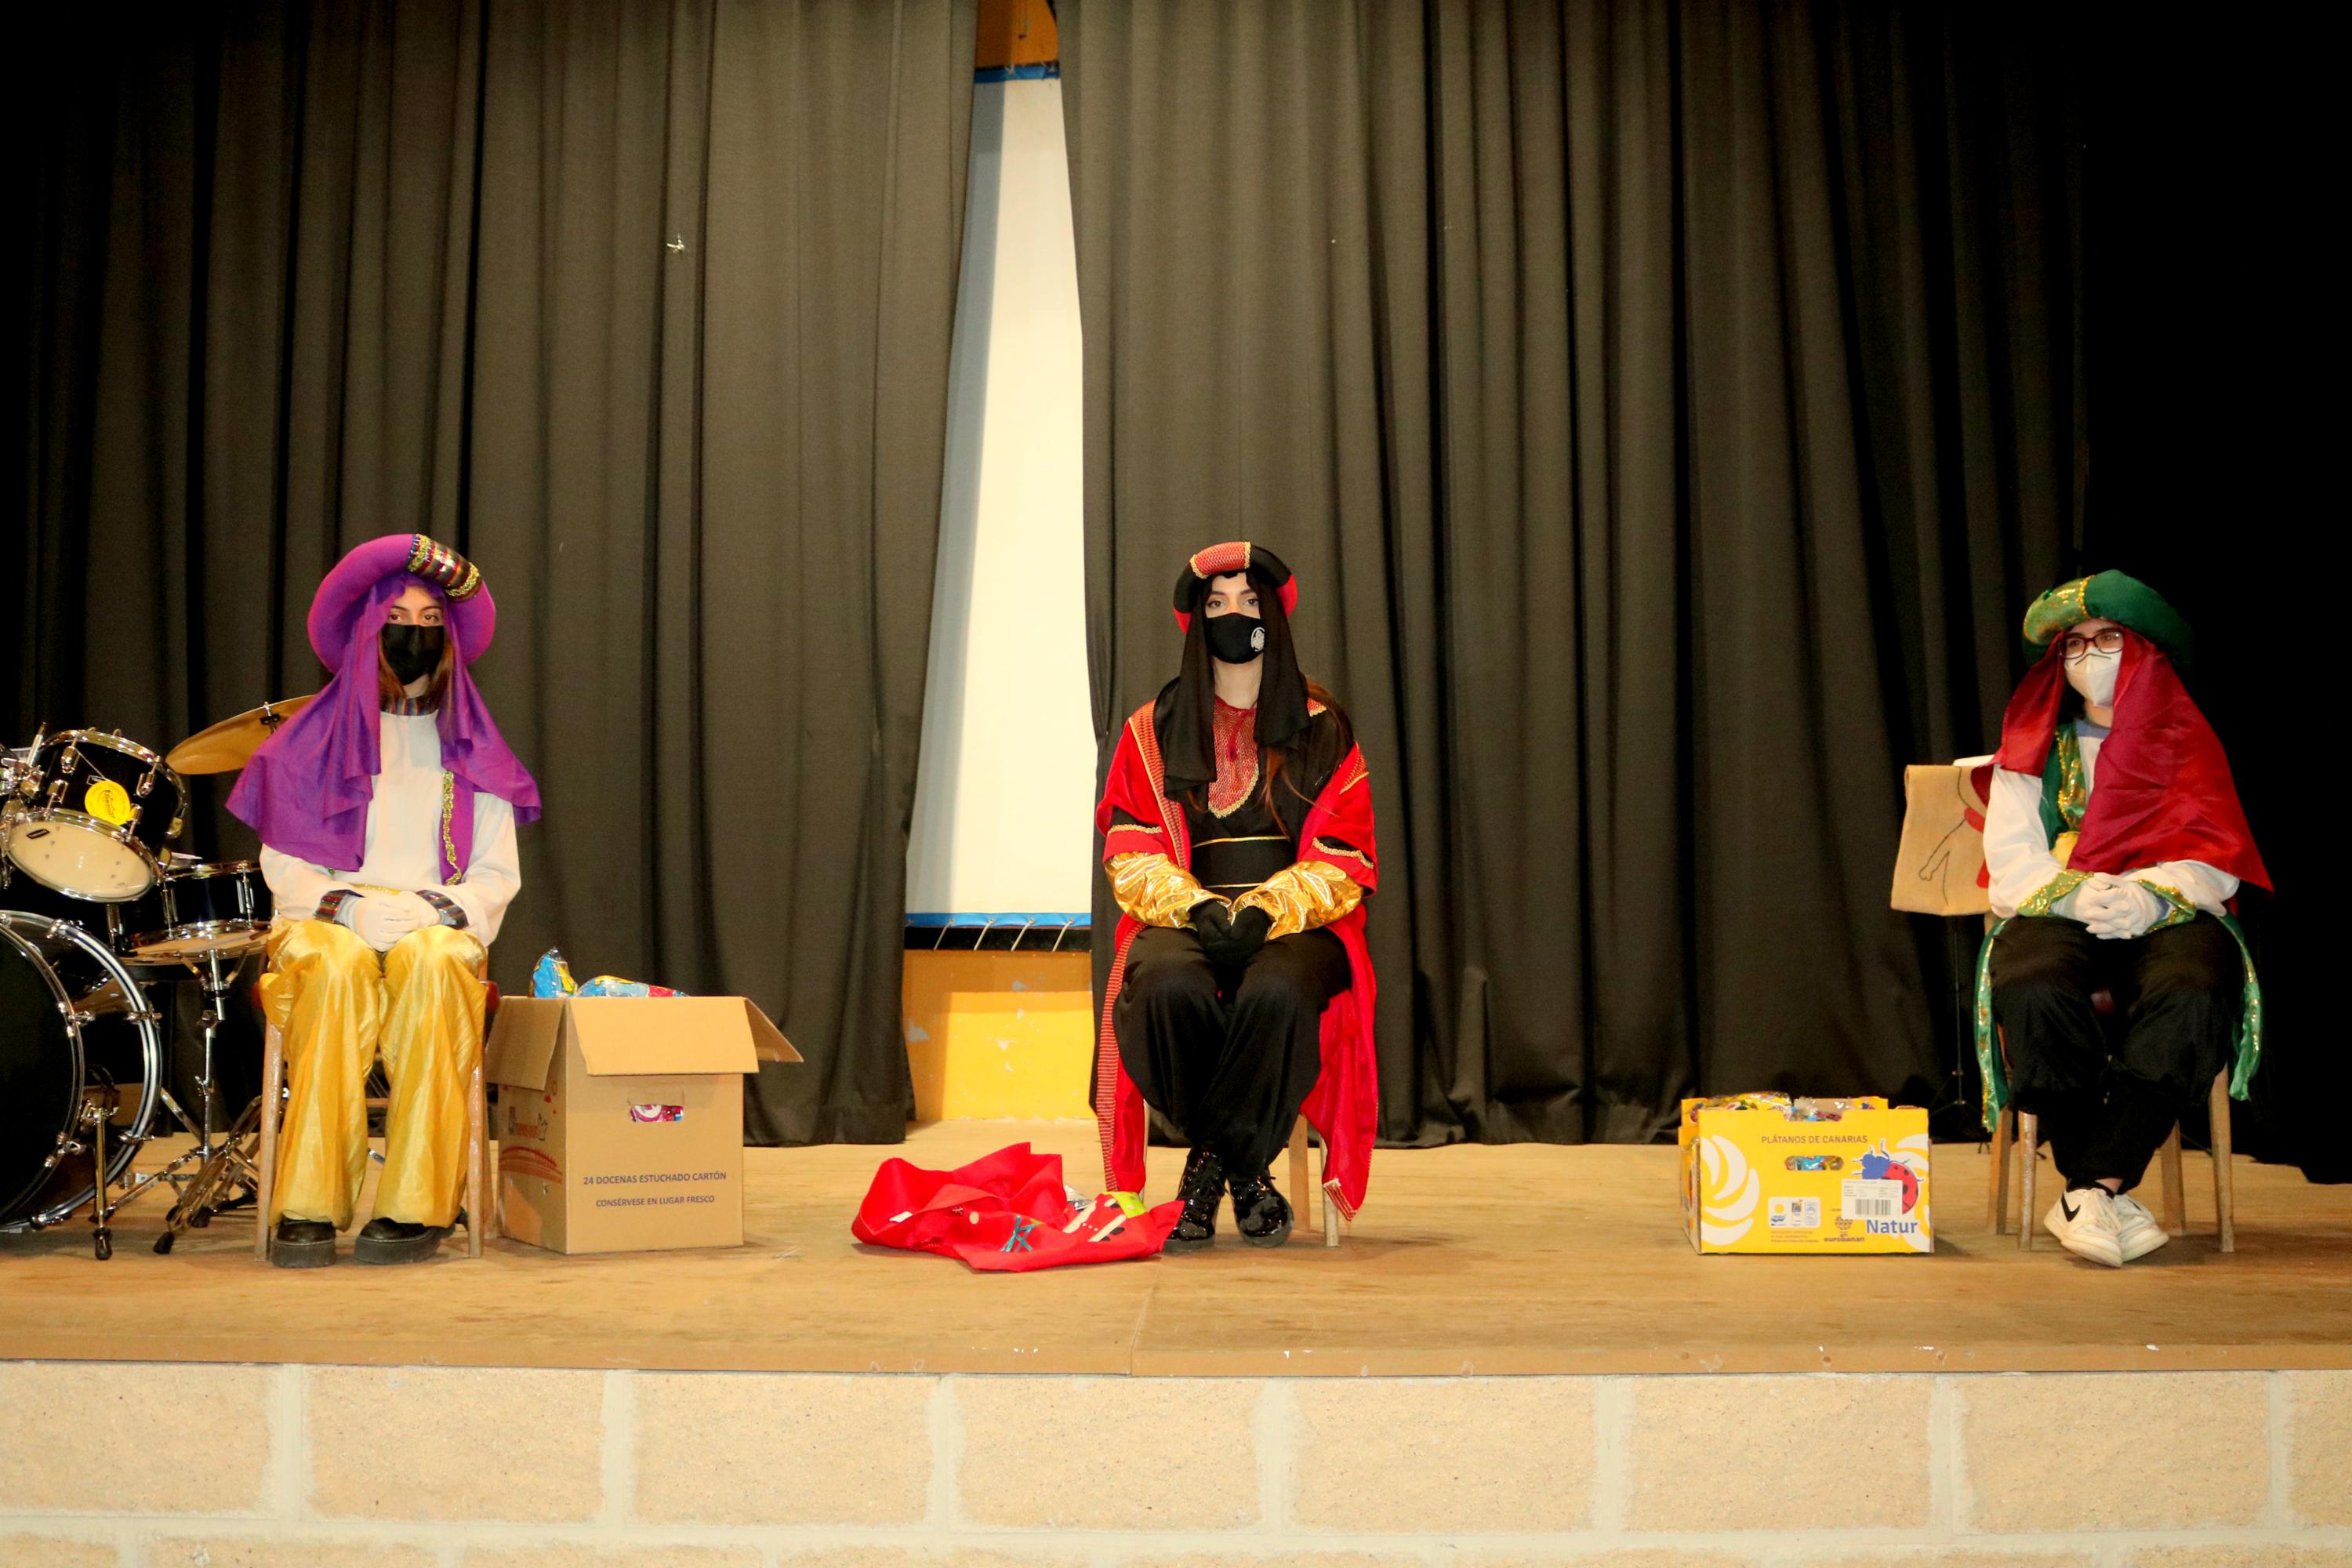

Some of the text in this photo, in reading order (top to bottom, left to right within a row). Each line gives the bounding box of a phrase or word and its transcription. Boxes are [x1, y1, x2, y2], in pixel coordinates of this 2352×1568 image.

[1762, 1134, 1806, 1144] PLÁTANOS
[1822, 1134, 1868, 1143] CANARIAS
[583, 1171, 727, 1185] 24 DOCENAS ESTUCHADO CARTÓN
[596, 1197, 645, 1207] CONSÉRVESE
[659, 1196, 684, 1205] LUGAR
[686, 1195, 715, 1203] FRESCO
[1866, 1219, 1918, 1234] Natur
